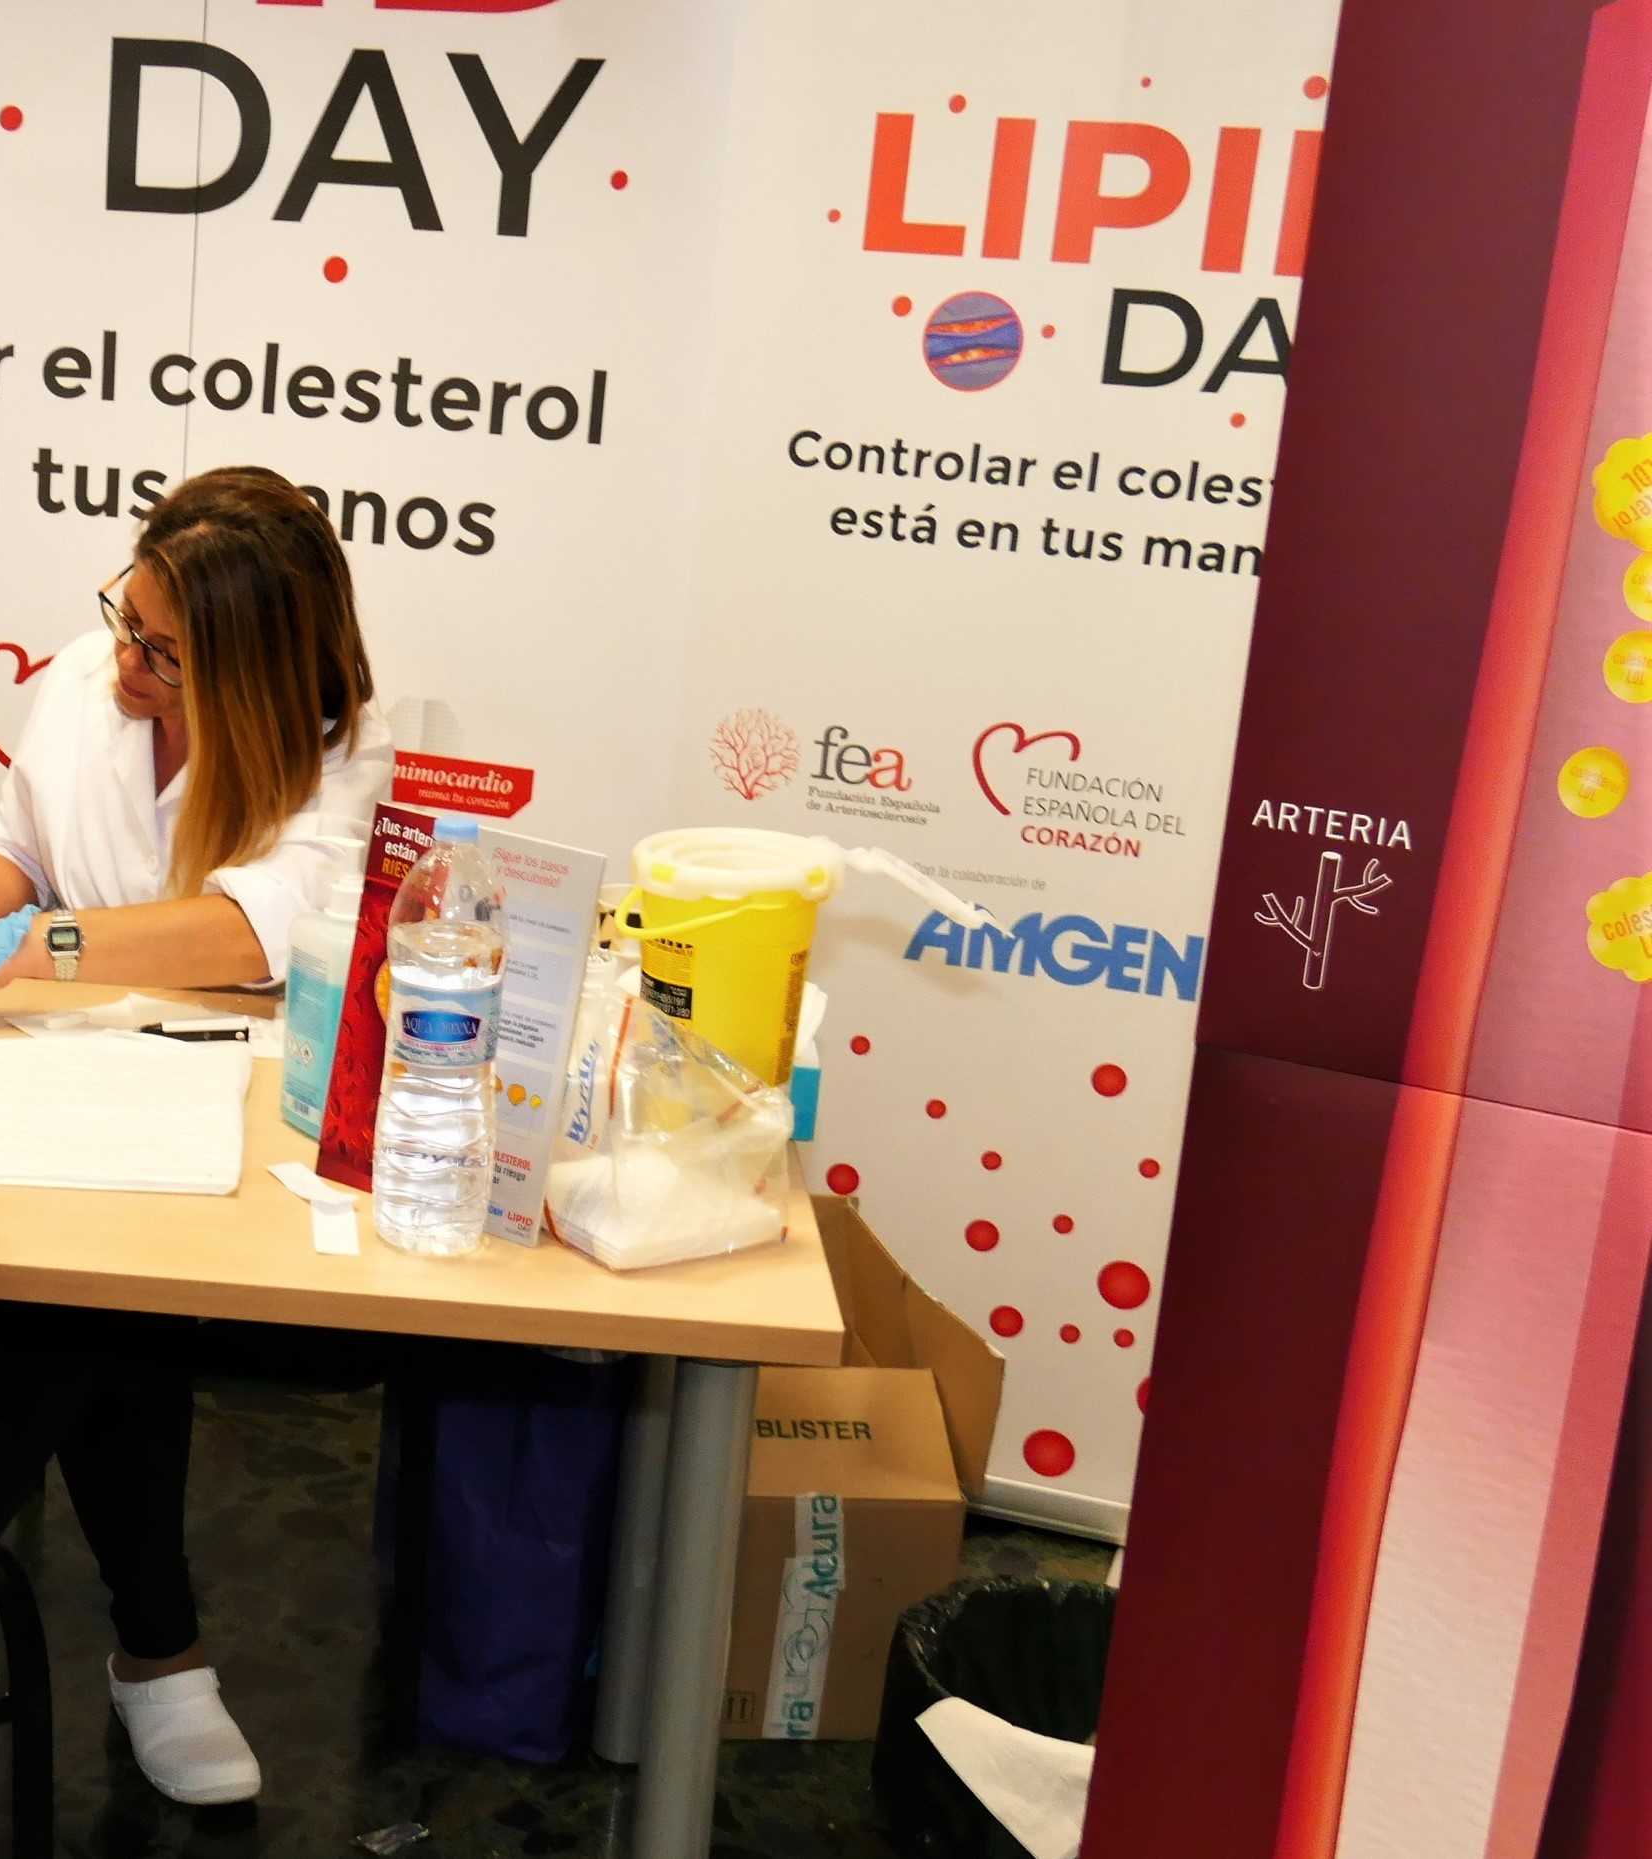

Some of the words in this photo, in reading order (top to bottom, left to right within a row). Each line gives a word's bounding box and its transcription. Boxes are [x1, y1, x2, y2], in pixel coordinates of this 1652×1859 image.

[106, 37, 606, 237] DAY
[1102, 288, 1291, 393] DA
[42, 331, 116, 401] el
[149, 342, 606, 444] colesterol
[33, 447, 168, 521] tus
[299, 484, 497, 556] nos
[788, 430, 1037, 488] Controlar
[1053, 452, 1100, 493] el
[1118, 460, 1275, 509] coles
[830, 503, 938, 546] está
[957, 519, 1018, 553] en
[1042, 518, 1123, 562] tus
[1143, 534, 1263, 577] man
[811, 725, 912, 791] fea
[1026, 767, 1163, 803] FUNDACIÓN
[374, 817, 401, 837] ¿Tus
[402, 826, 435, 847] arteri
[1020, 825, 1142, 858] CORAZÓN
[1022, 795, 1137, 829] ESPAÑOLA
[1144, 811, 1186, 837] DEL
[1252, 799, 1412, 851] ARTERIA
[381, 857, 411, 879] RIES
[904, 902, 1206, 1002] AMGEN
[755, 1418, 872, 1442] BLISTER
